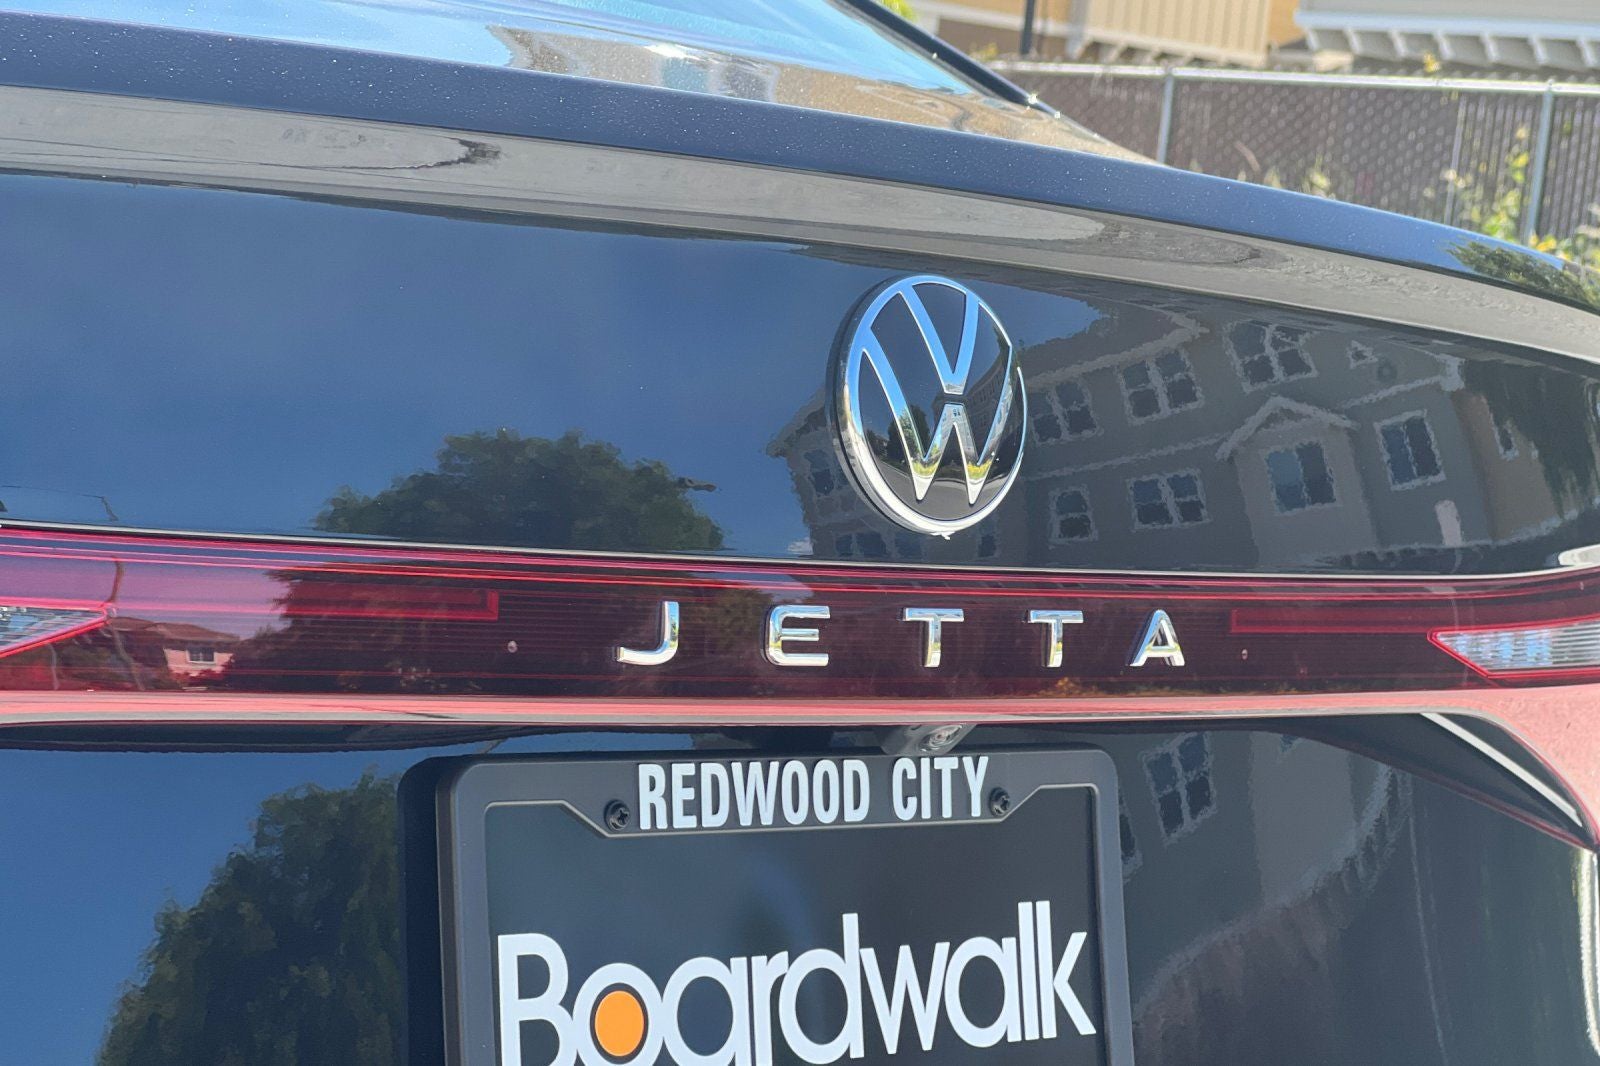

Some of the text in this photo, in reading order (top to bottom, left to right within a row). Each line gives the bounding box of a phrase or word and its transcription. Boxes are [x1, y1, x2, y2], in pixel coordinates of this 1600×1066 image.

[616, 601, 1186, 668] JETTA
[638, 755, 990, 830] REDWOOD CITY
[497, 900, 1097, 1066] Boardwalk
